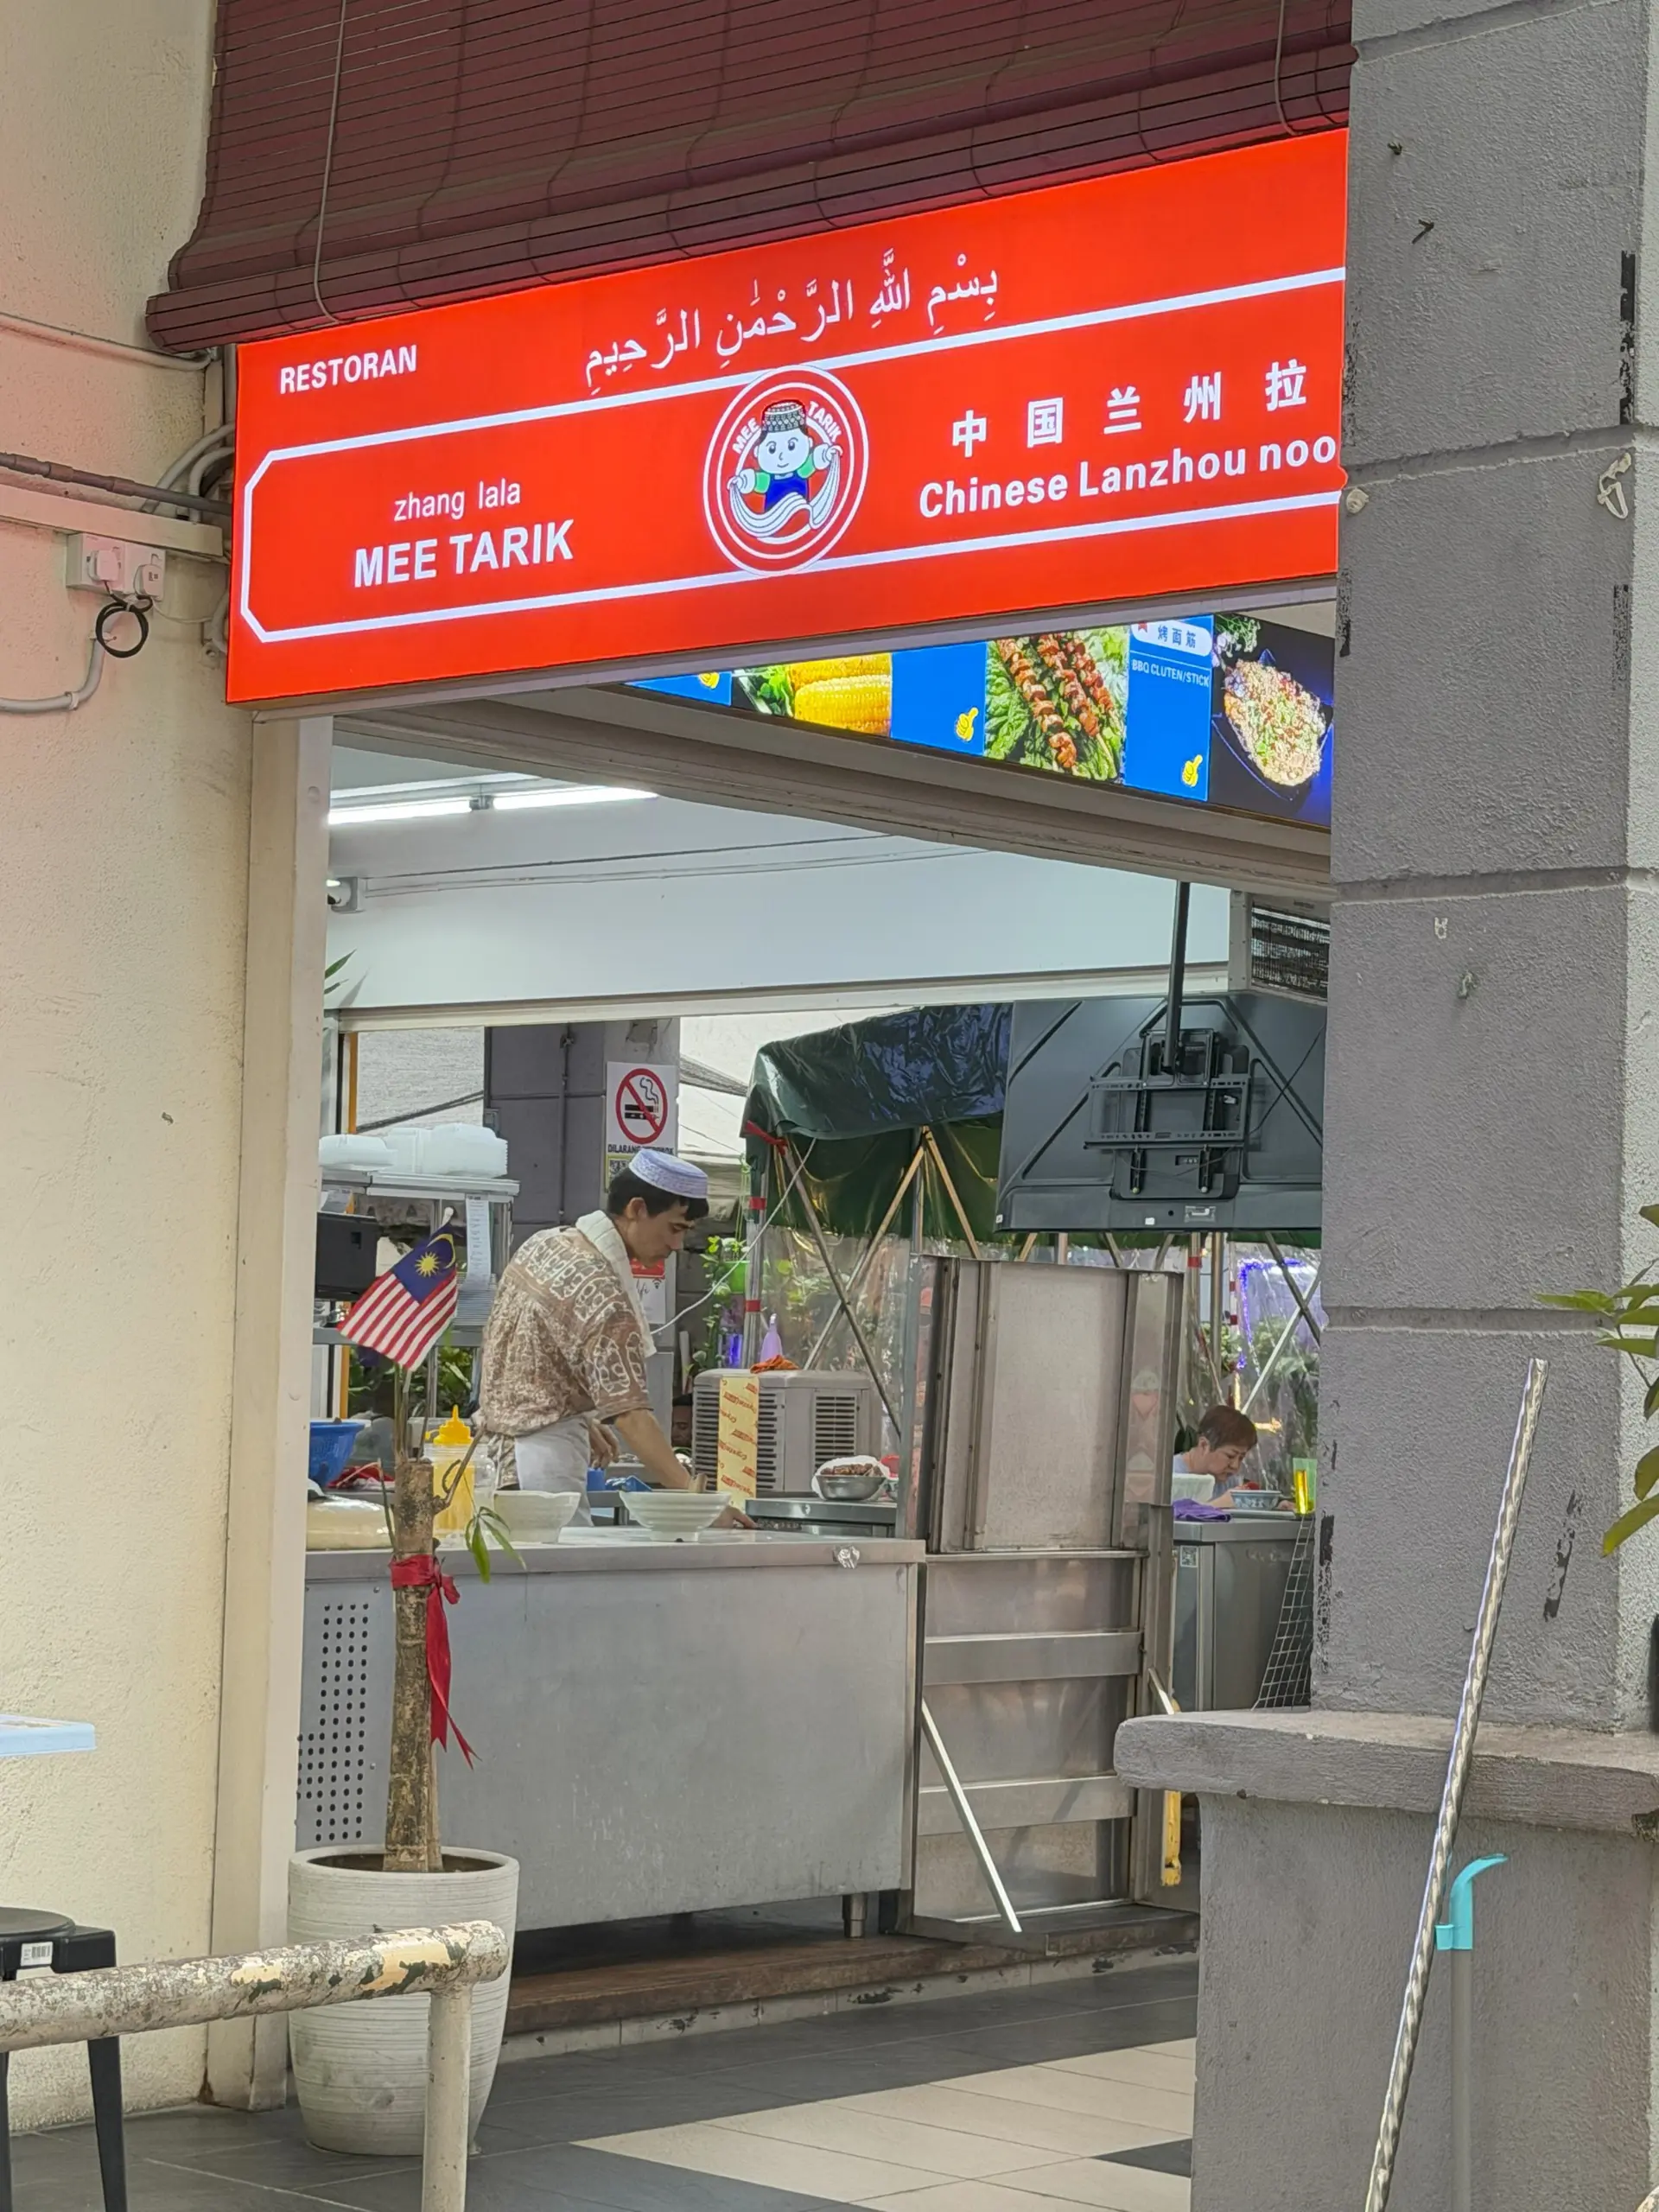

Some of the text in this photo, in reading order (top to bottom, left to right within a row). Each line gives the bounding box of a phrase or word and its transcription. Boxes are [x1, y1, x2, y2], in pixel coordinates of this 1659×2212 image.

[280, 344, 416, 394] RESTORAN
[731, 400, 843, 454] MEE TARIK
[951, 359, 1307, 458] 中国兰州拉
[393, 478, 521, 521] zhang lala
[919, 476, 1068, 518] Chinese
[1079, 448, 1246, 498] Lanzhou
[354, 518, 574, 588] MEE TARIK
[1132, 658, 1149, 674] BBQ
